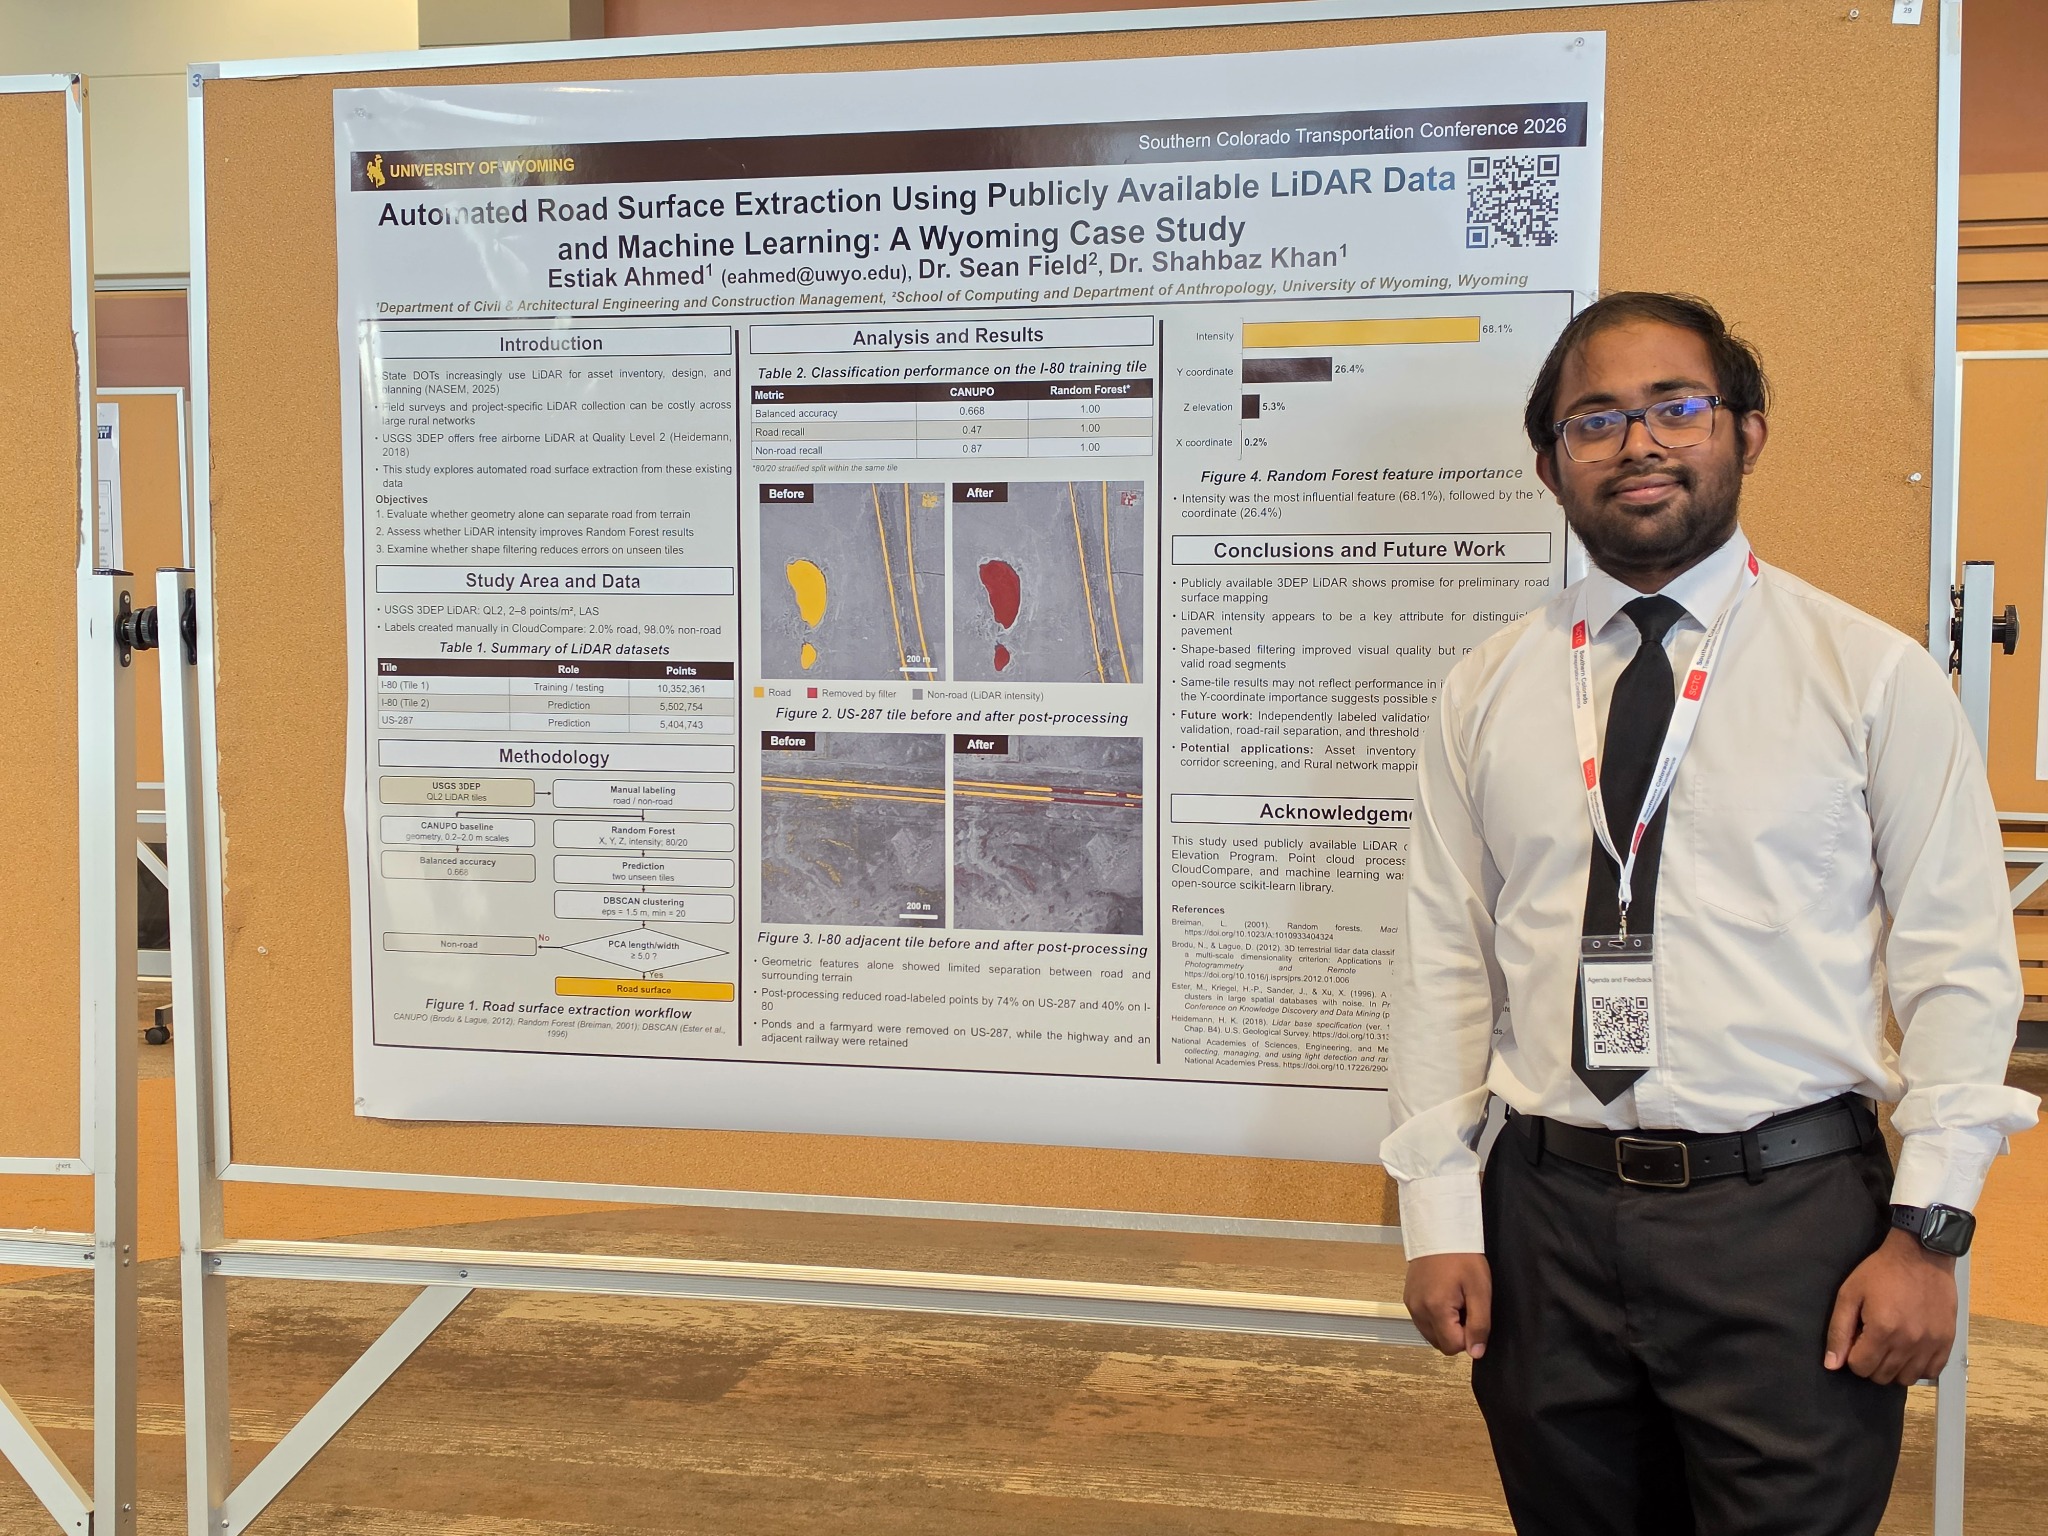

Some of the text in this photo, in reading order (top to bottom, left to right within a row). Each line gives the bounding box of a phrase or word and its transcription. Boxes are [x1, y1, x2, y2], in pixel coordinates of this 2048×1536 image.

[192, 73, 202, 88] 3
[1138, 117, 1567, 150] Southern Colorado Transportation Conference 2026
[389, 157, 575, 179] UNIVERSITY OF WYOMING
[537, 196, 608, 223] Road
[618, 193, 725, 220] Surface
[735, 188, 881, 216] Extraction
[892, 184, 976, 215] Using
[988, 179, 1109, 211] Publicly
[1117, 173, 1259, 203] Available
[1271, 168, 1372, 198] LiDAR
[1384, 166, 1455, 193] Data
[558, 215, 1246, 261] and Machine Learning: A Wyoming Case Study
[548, 267, 618, 288] Estiak
[721, 263, 912, 289] (eahmed@uwyo.edu),
[919, 258, 951, 279] Dr.
[959, 257, 1019, 278] Sean
[1110, 252, 1143, 274] Dr.
[1152, 249, 1262, 273] Shahbaz
[1482, 324, 1513, 334] 68.1%
[852, 326, 1044, 350] Analysis and Results
[1196, 331, 1235, 343] Intensity
[500, 335, 603, 352] Introduction
[758, 360, 1147, 380] Table 2. Classification performance on the I-80 training tile
[1176, 367, 1234, 377] Y coordinate
[1334, 364, 1365, 374] 26.4%
[754, 390, 785, 400] Metric
[949, 386, 995, 397] CANUPO
[1050, 384, 1092, 395] Random
[959, 406, 985, 417] 0.668
[1080, 404, 1101, 414] 1.00
[1183, 402, 1233, 412] Z elevation
[1262, 401, 1286, 411] 5.3%
[755, 408, 838, 420] Balanced accuracy
[754, 427, 805, 438] Road recall
[962, 425, 982, 436] 0.47
[1081, 423, 1101, 434] 1.00
[1080, 441, 1101, 453] 1.00
[1175, 437, 1233, 447] X coordinate
[1244, 437, 1268, 447] 0.2%
[755, 446, 823, 456] Non-road recall
[962, 444, 982, 454] 0.87
[1200, 467, 1523, 486] Figure 4. Random Forest feature importance
[769, 488, 805, 499] Before
[966, 487, 994, 498] After
[375, 494, 429, 506] Objectives
[376, 509, 691, 521] 1. Evaluate whether geometry alone can separate road from terrain
[1214, 540, 1506, 559] Conclusions and Future Work
[466, 572, 640, 592] Study Area and Data
[1181, 576, 1550, 591] Publicly available 3DEP LiDAR shows promise for preliminary road
[380, 662, 398, 673] Tile
[557, 664, 580, 674] Role
[666, 665, 697, 676] Points
[381, 679, 430, 691] I-80 (Tile 1)
[533, 681, 568, 695] Training
[575, 683, 604, 694] testing
[657, 683, 705, 694] 10,352,361
[1689, 674, 1702, 696] SCTC
[381, 697, 430, 709] I-80 (Tile 2)
[547, 699, 591, 711] Prediction
[659, 702, 703, 712] 5,502,754
[381, 714, 414, 726] US-287
[548, 717, 591, 728] Prediction
[775, 707, 1129, 727] Figure 2. US-287 tile before and after post-processing
[659, 719, 704, 730] 5,404,743
[499, 747, 610, 769] Methodology
[1171, 904, 1225, 915] References
[538, 933, 550, 943] No
[616, 983, 672, 997] Road surface
